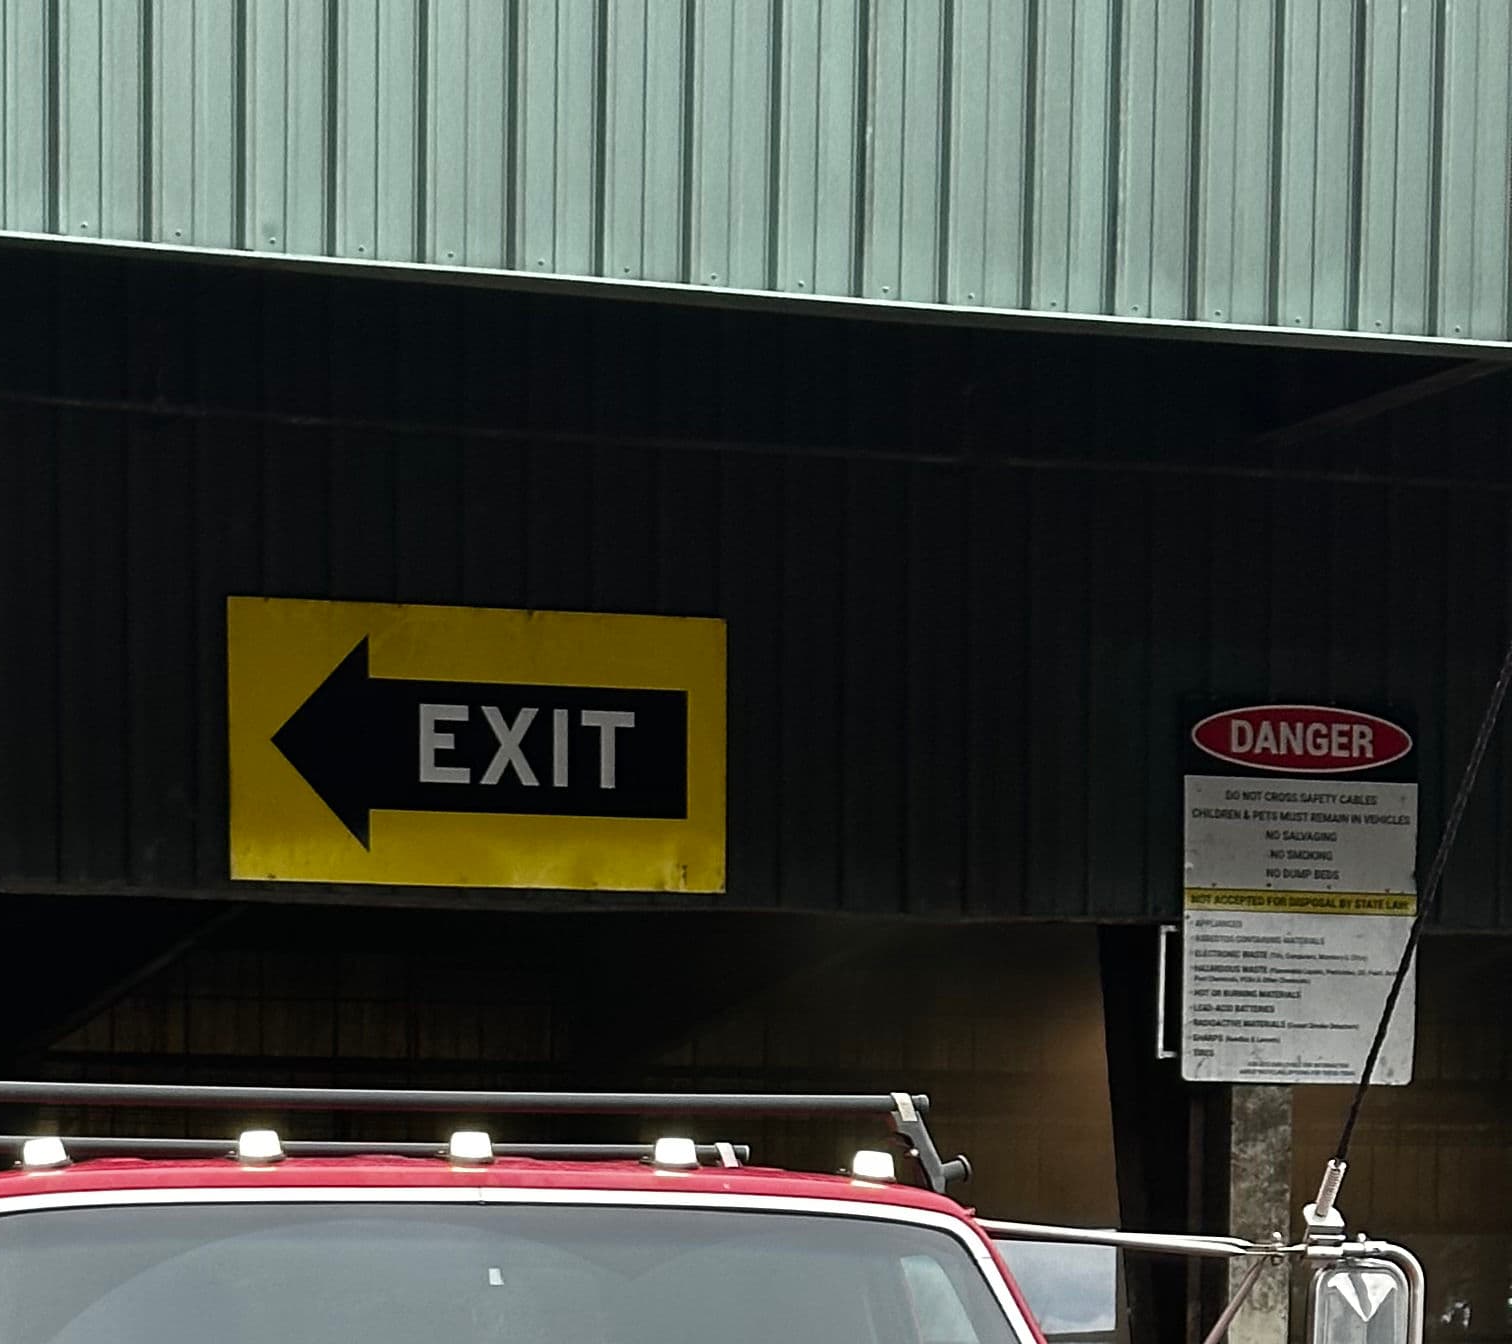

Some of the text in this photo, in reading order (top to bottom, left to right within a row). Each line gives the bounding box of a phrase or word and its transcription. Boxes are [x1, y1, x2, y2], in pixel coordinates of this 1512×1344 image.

[1231, 718, 1374, 759] DANGER
[418, 702, 636, 790] EXIT
[1266, 830, 1281, 840] NO
[1270, 849, 1285, 859] NO
[1266, 868, 1281, 878] NO
